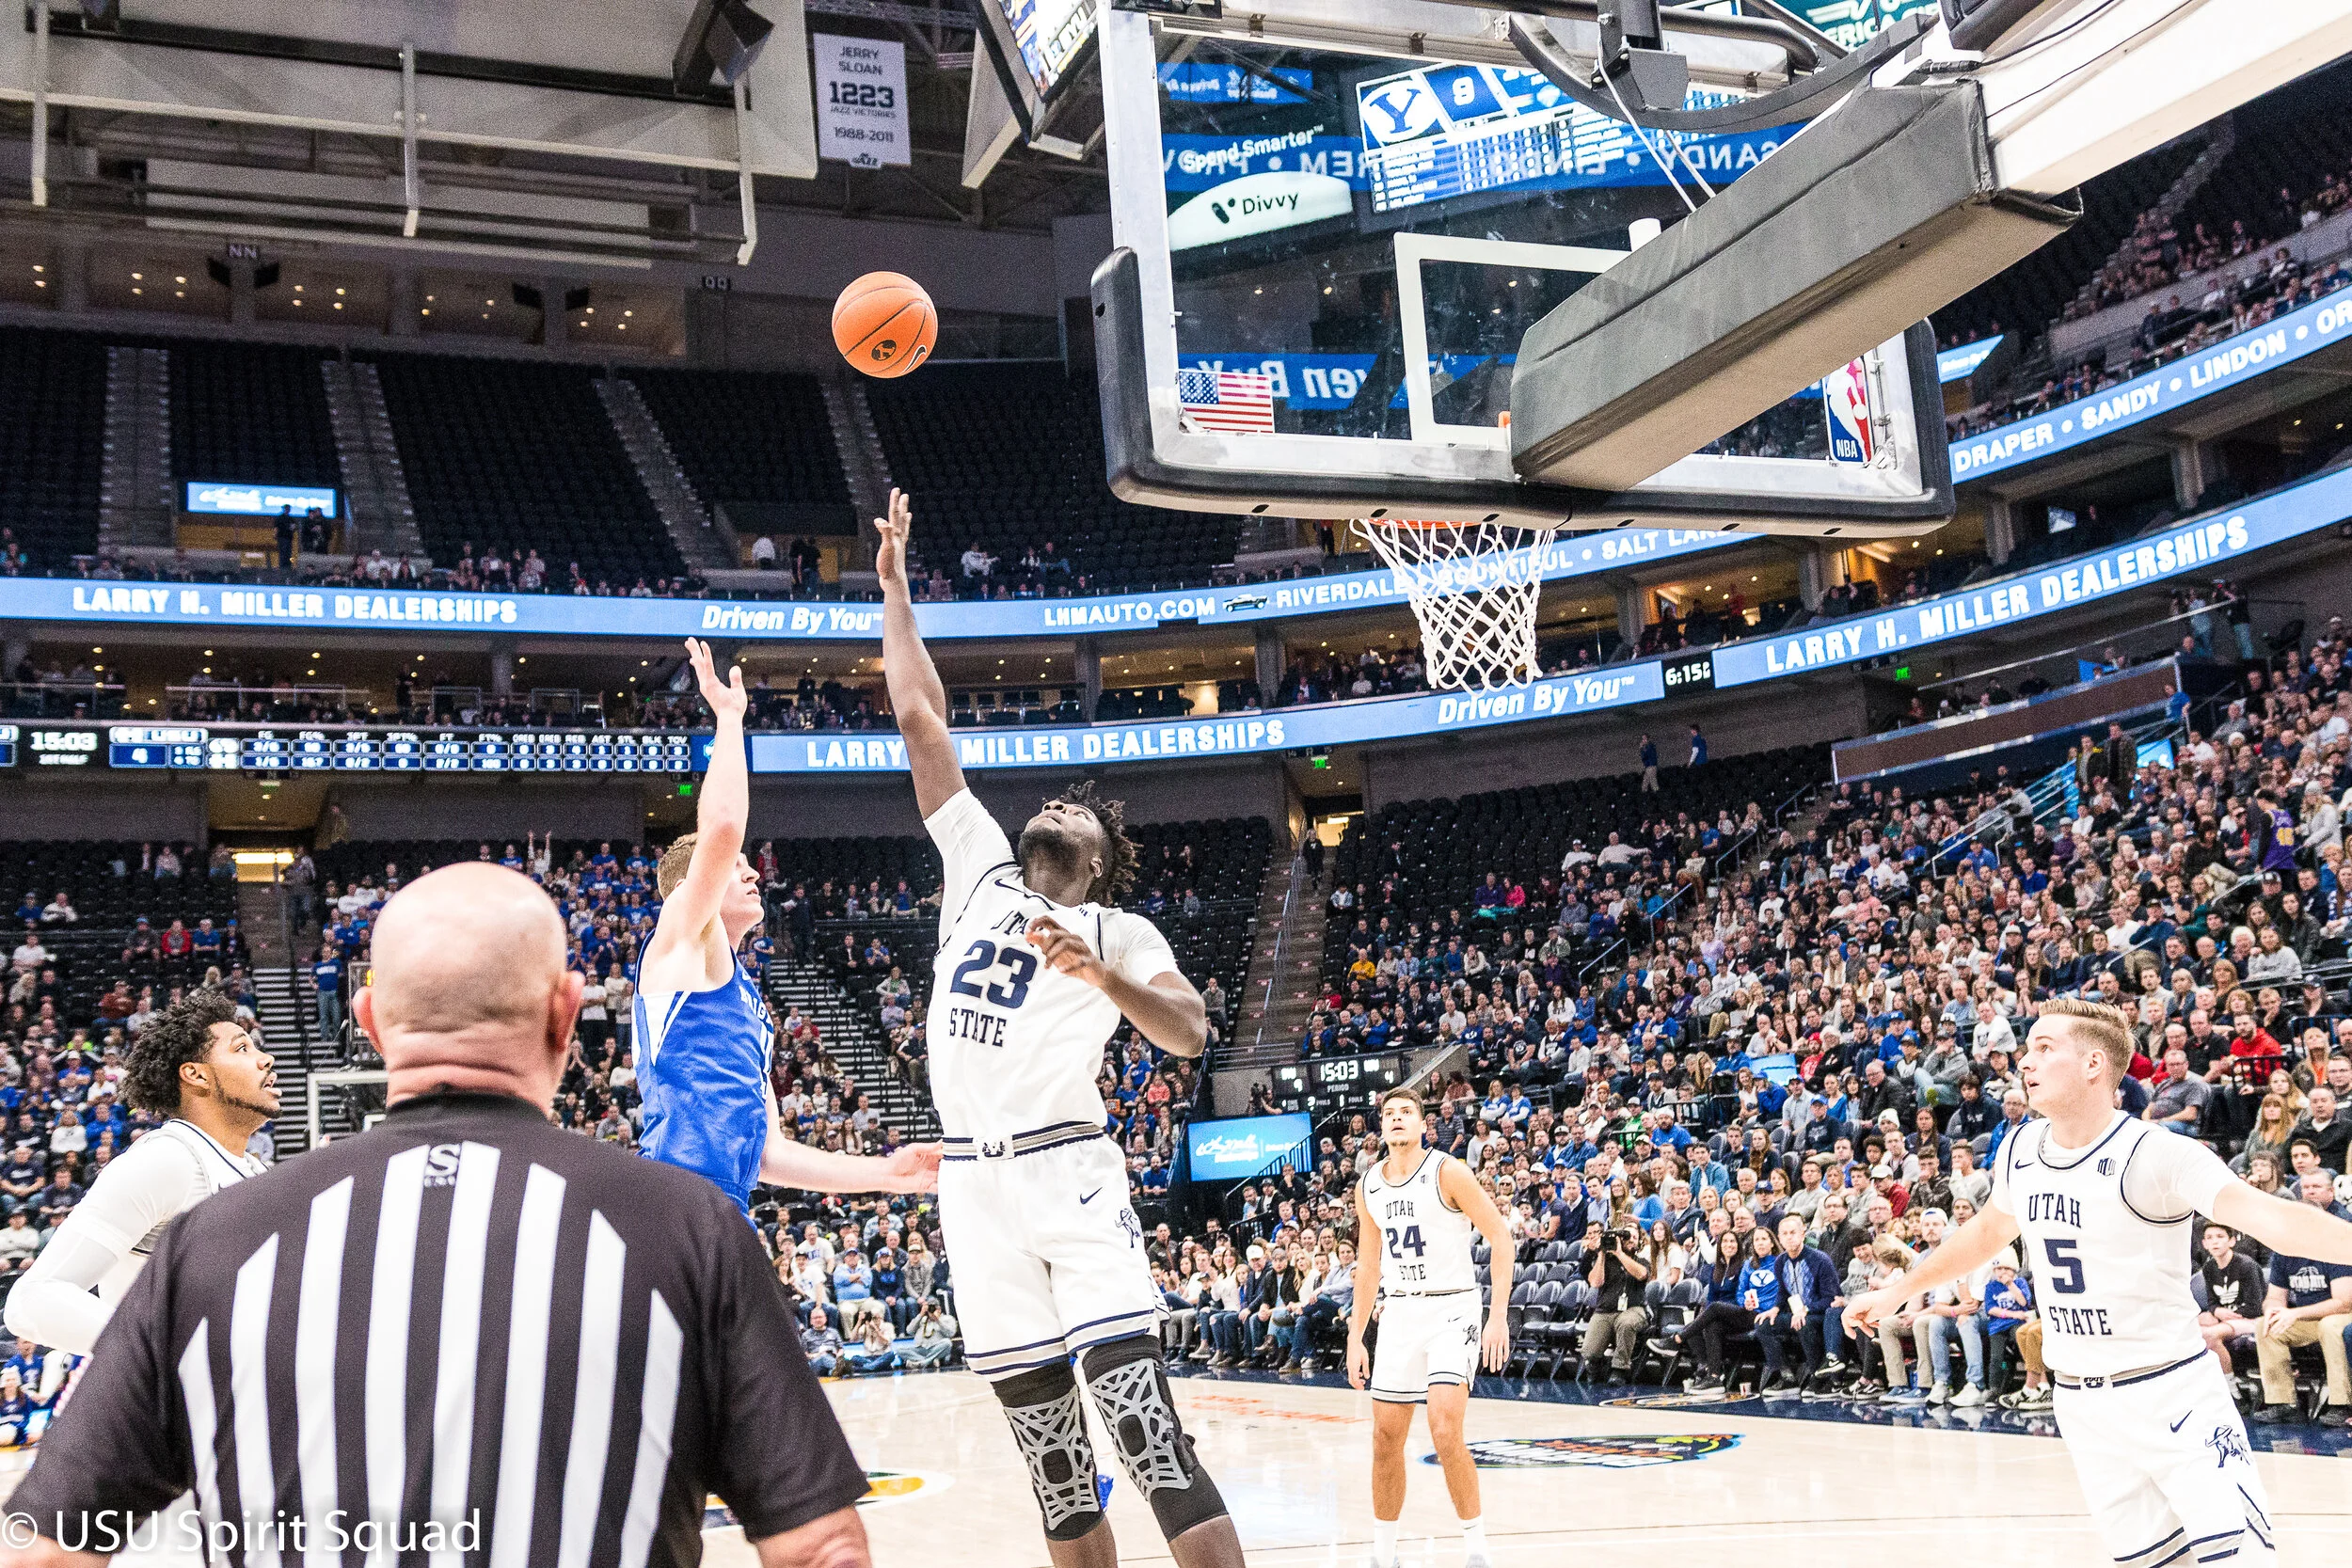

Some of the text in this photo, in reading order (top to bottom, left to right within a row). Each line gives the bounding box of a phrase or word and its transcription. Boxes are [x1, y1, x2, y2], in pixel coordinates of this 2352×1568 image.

[839, 46, 880, 58] JERRY
[839, 61, 882, 75] SLOAN
[829, 81, 894, 108] 1223
[831, 105, 897, 119] JAZZ VICTORIES
[1369, 88, 1422, 134] Y
[834, 127, 894, 143] 1988-2011
[1184, 142, 1240, 173] Spend
[1243, 193, 1299, 214] Divvy
[1954, 423, 2054, 473] DRAPER
[2081, 381, 2160, 431] SANDY
[2190, 329, 2287, 388] LINDON
[1836, 439, 1858, 458] NBA
[1601, 531, 1659, 560] SALT
[72, 587, 517, 623] LARRY H. MILLER DEALERSHIPS
[1766, 515, 2249, 674] LARRY H. MILLER DEALERSHIPS
[701, 605, 784, 631] Driven
[790, 607, 825, 633] By
[1044, 598, 1216, 626] LHMAUTO.COM
[1438, 696, 1524, 724] Driven
[1534, 687, 1566, 713] By
[30, 731, 98, 751] 15:03
[592, 735, 612, 744] AST
[617, 735, 636, 744] STL
[806, 719, 1285, 768] LARRY MILLER DEALERSHIPS
[949, 940, 1037, 1009] 23
[949, 1007, 1008, 1047] STATE
[1294, 1070, 1394, 1093] 9 PERIOD 4
[1320, 1060, 1359, 1082] 15:03
[1369, 1090, 1376, 1105] 3
[1386, 1200, 1415, 1219] UTAH
[2028, 1193, 2081, 1228] UTAH
[1386, 1225, 1426, 1259] 24
[2043, 1238, 2086, 1294] 5
[2049, 1306, 2112, 1336] STATE
